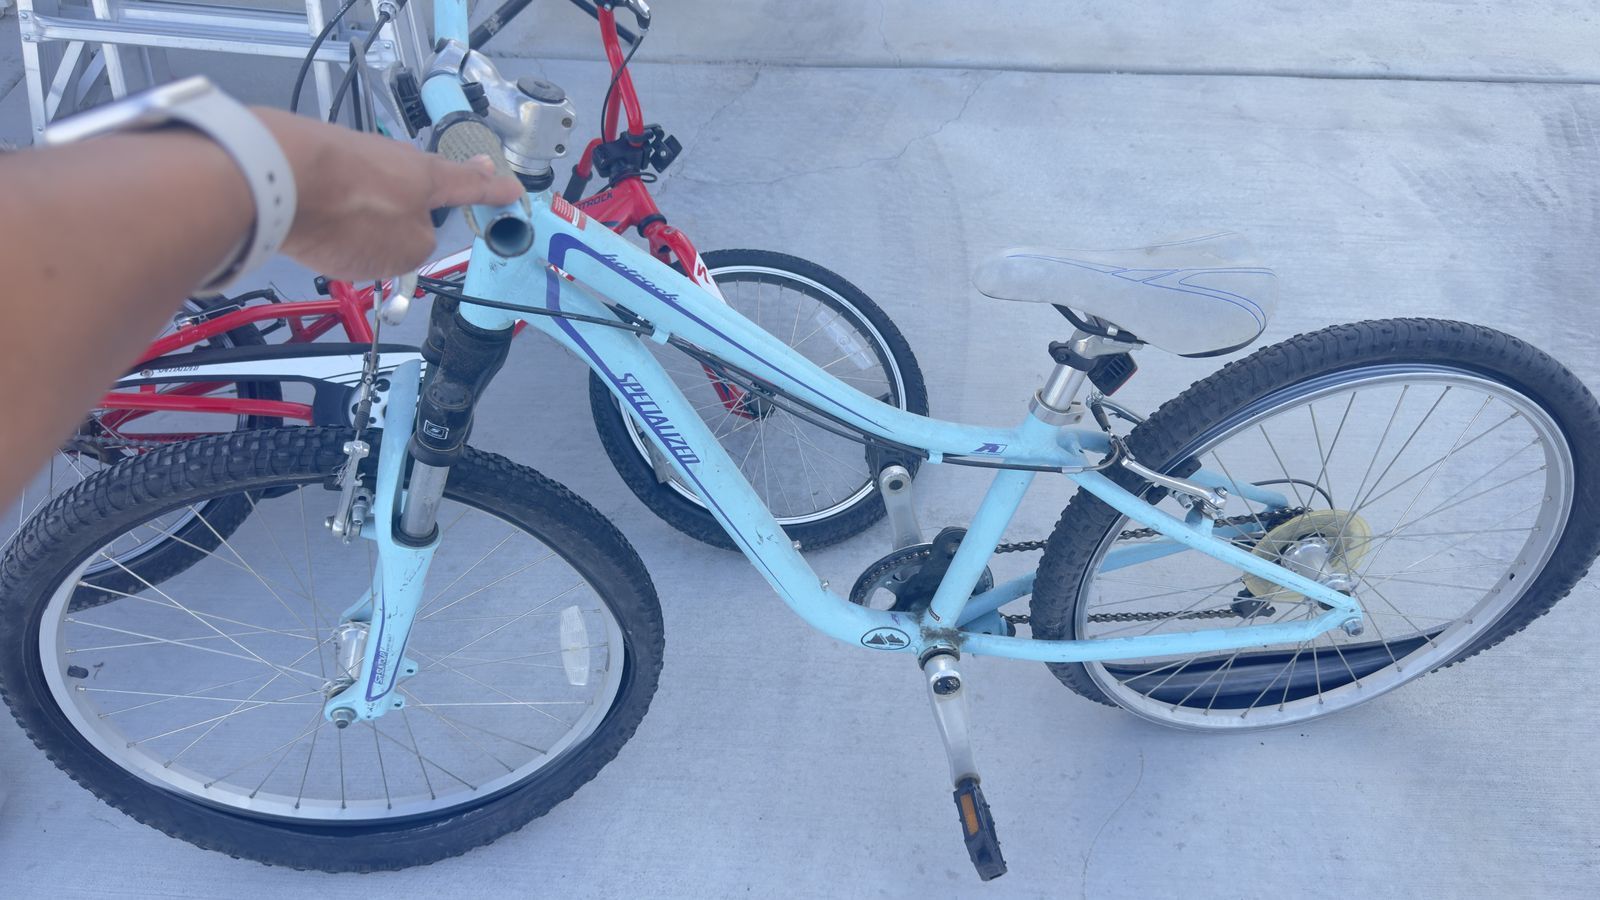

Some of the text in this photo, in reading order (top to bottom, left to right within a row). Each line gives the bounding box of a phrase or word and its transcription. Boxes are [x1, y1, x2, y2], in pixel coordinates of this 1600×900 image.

[574, 190, 613, 211] OTROCK
[599, 253, 679, 301] hotrock
[617, 373, 701, 464] SPECIALIZED
